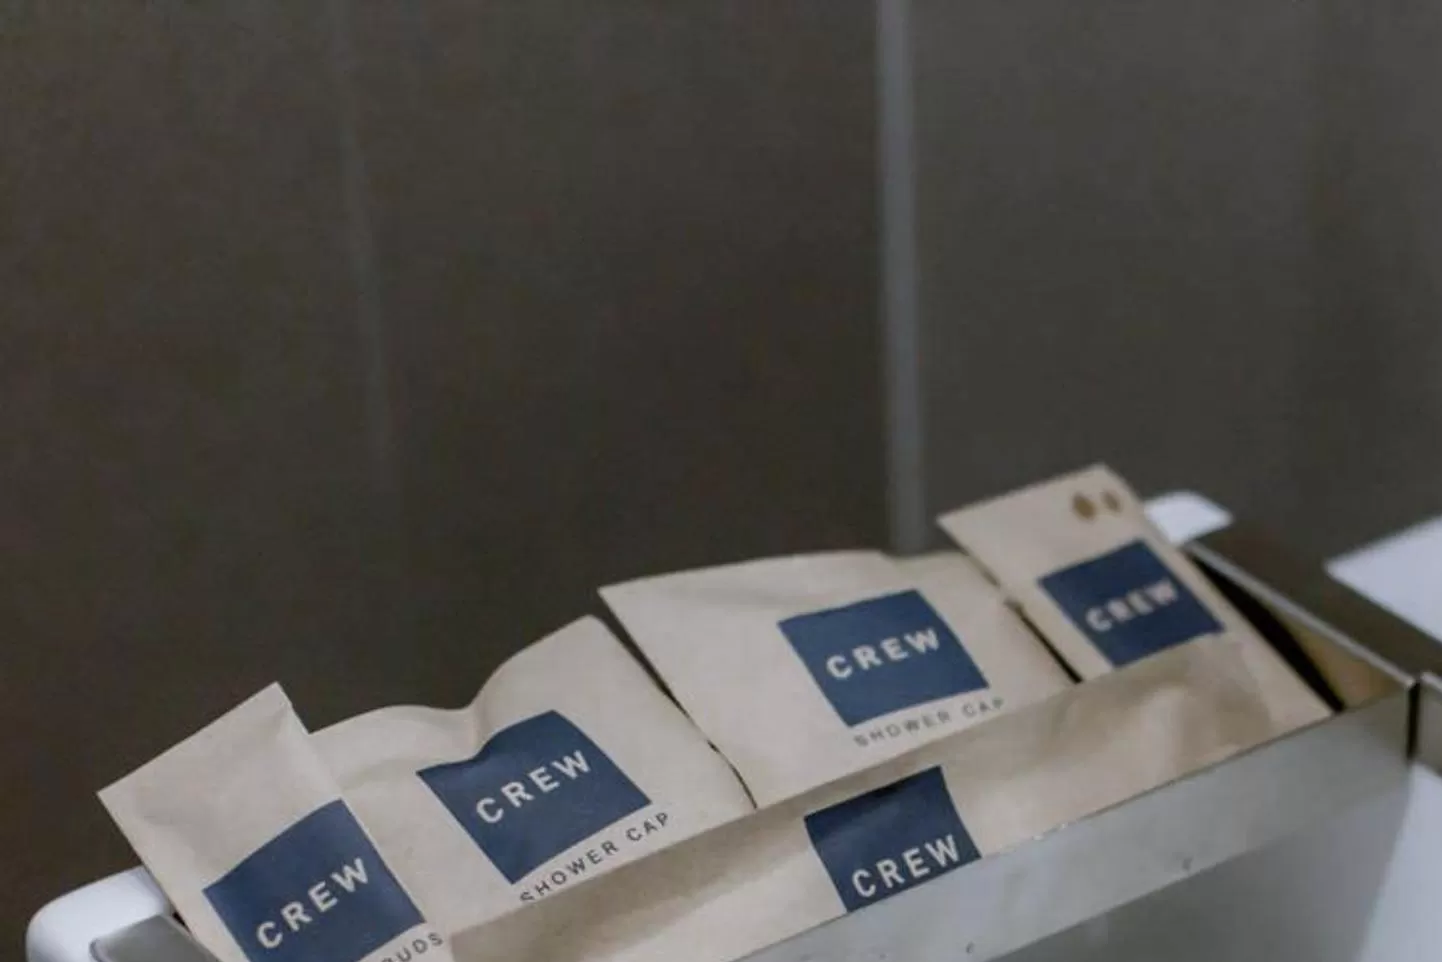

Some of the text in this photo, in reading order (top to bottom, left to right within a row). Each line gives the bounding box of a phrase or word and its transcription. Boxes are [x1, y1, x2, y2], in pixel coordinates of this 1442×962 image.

[1085, 578, 1178, 632] CREW
[826, 627, 939, 680] CREW
[854, 697, 1006, 748] SHOWER CAP
[476, 750, 591, 824] CREW
[519, 812, 669, 901] SHOWER CAP
[852, 835, 960, 898] CREW
[256, 857, 368, 950] CREW
